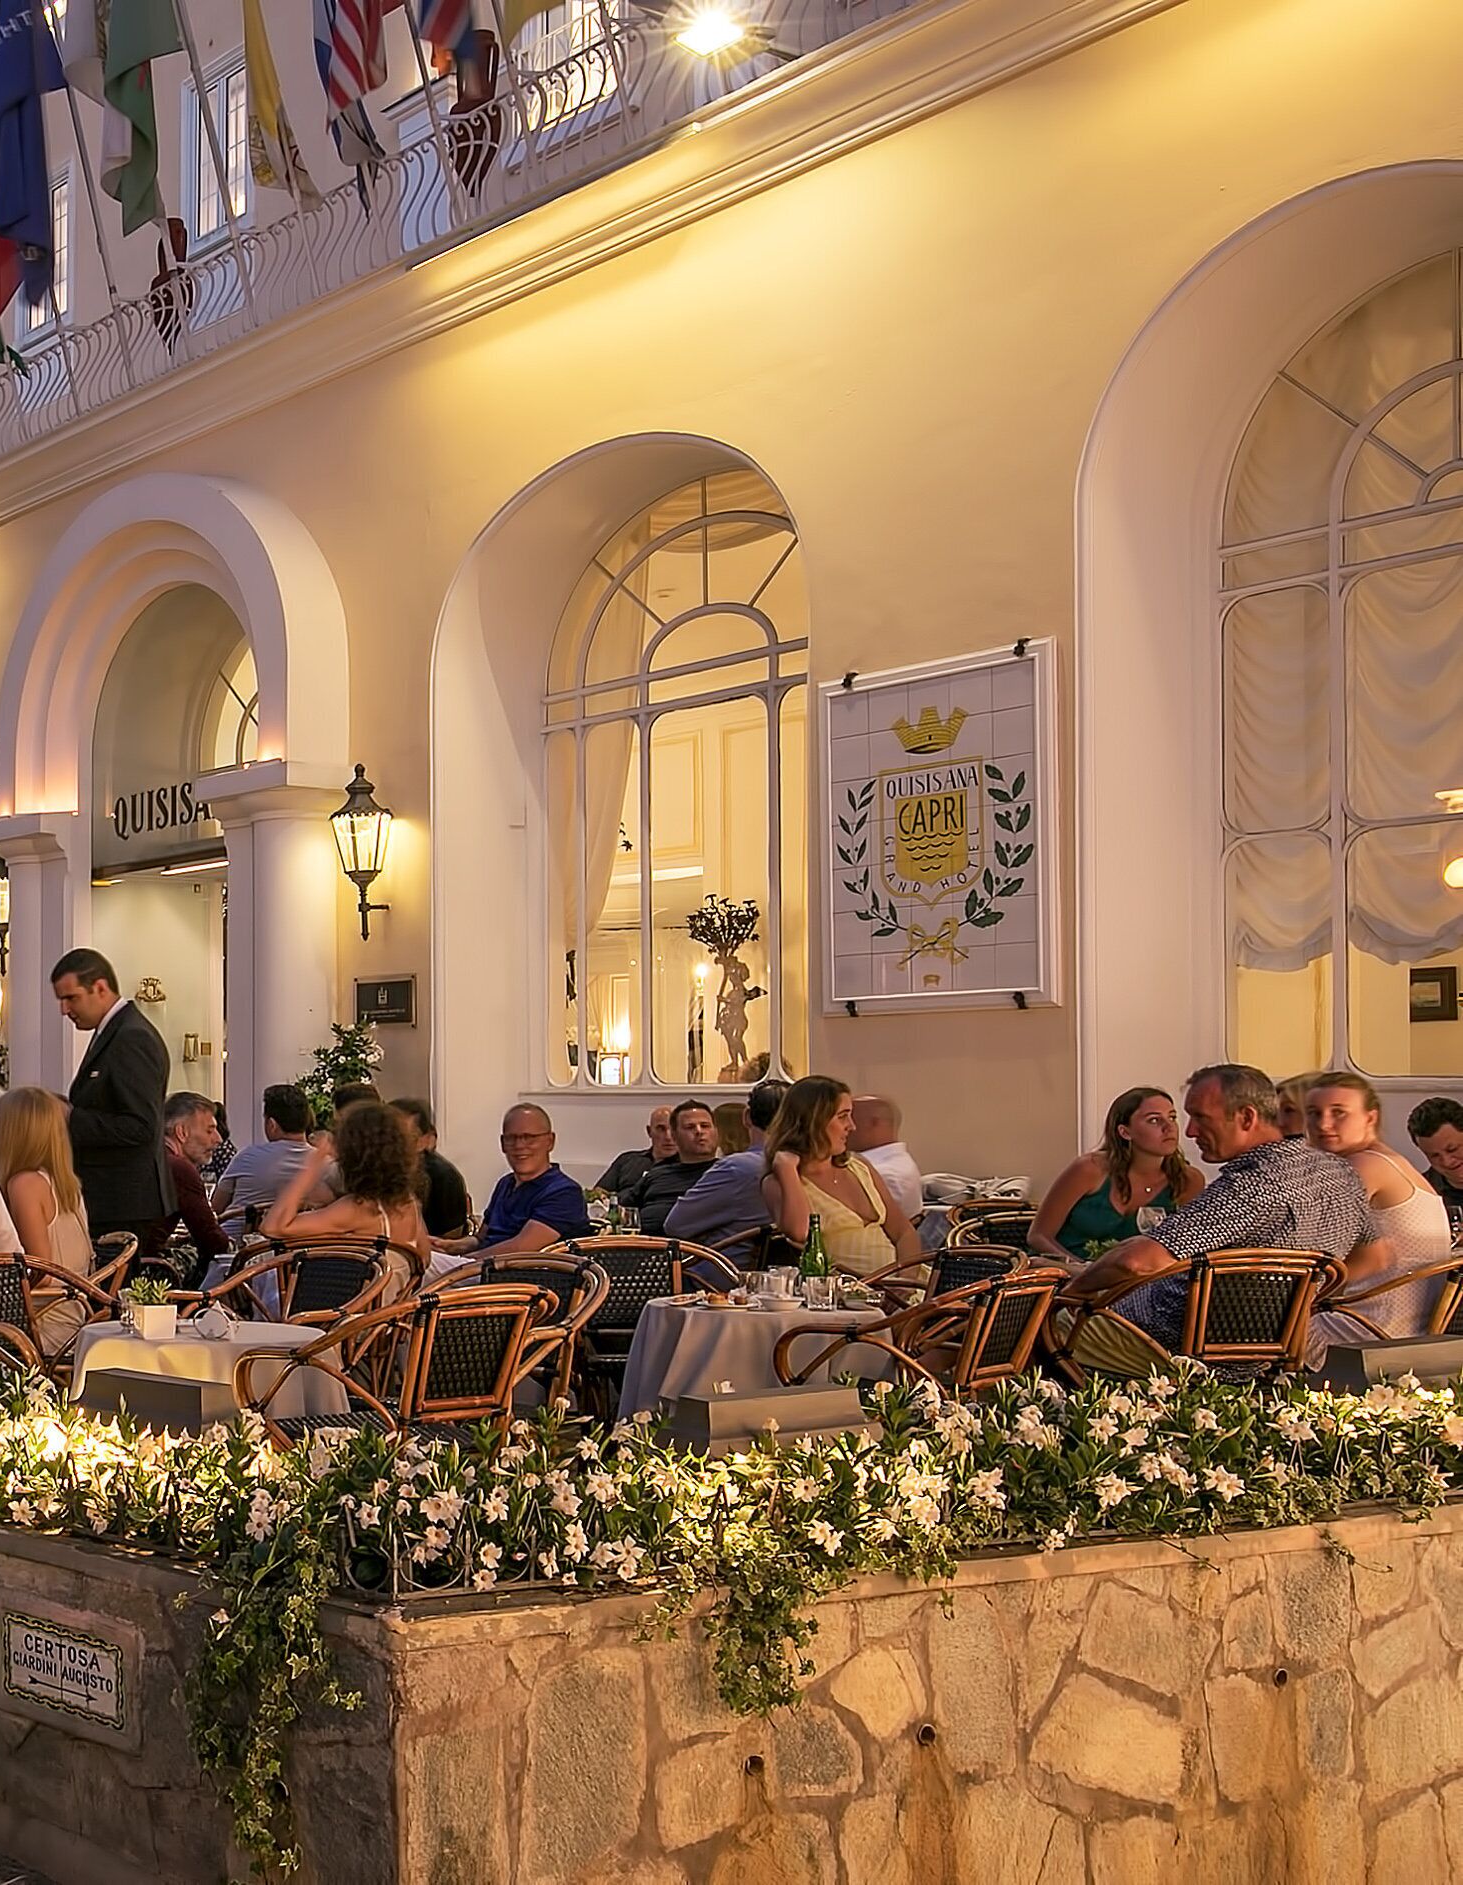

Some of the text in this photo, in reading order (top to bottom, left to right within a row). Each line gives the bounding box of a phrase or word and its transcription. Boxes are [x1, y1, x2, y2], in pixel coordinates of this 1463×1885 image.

[886, 765, 979, 799] QUISISANA
[113, 782, 215, 841] QUISISA
[898, 794, 964, 835] CAPRI
[884, 828, 979, 893] GRAND HOTEL
[13, 1651, 113, 1693] GIARDINI AUGUSTO
[24, 1633, 101, 1672] CERTOSA
